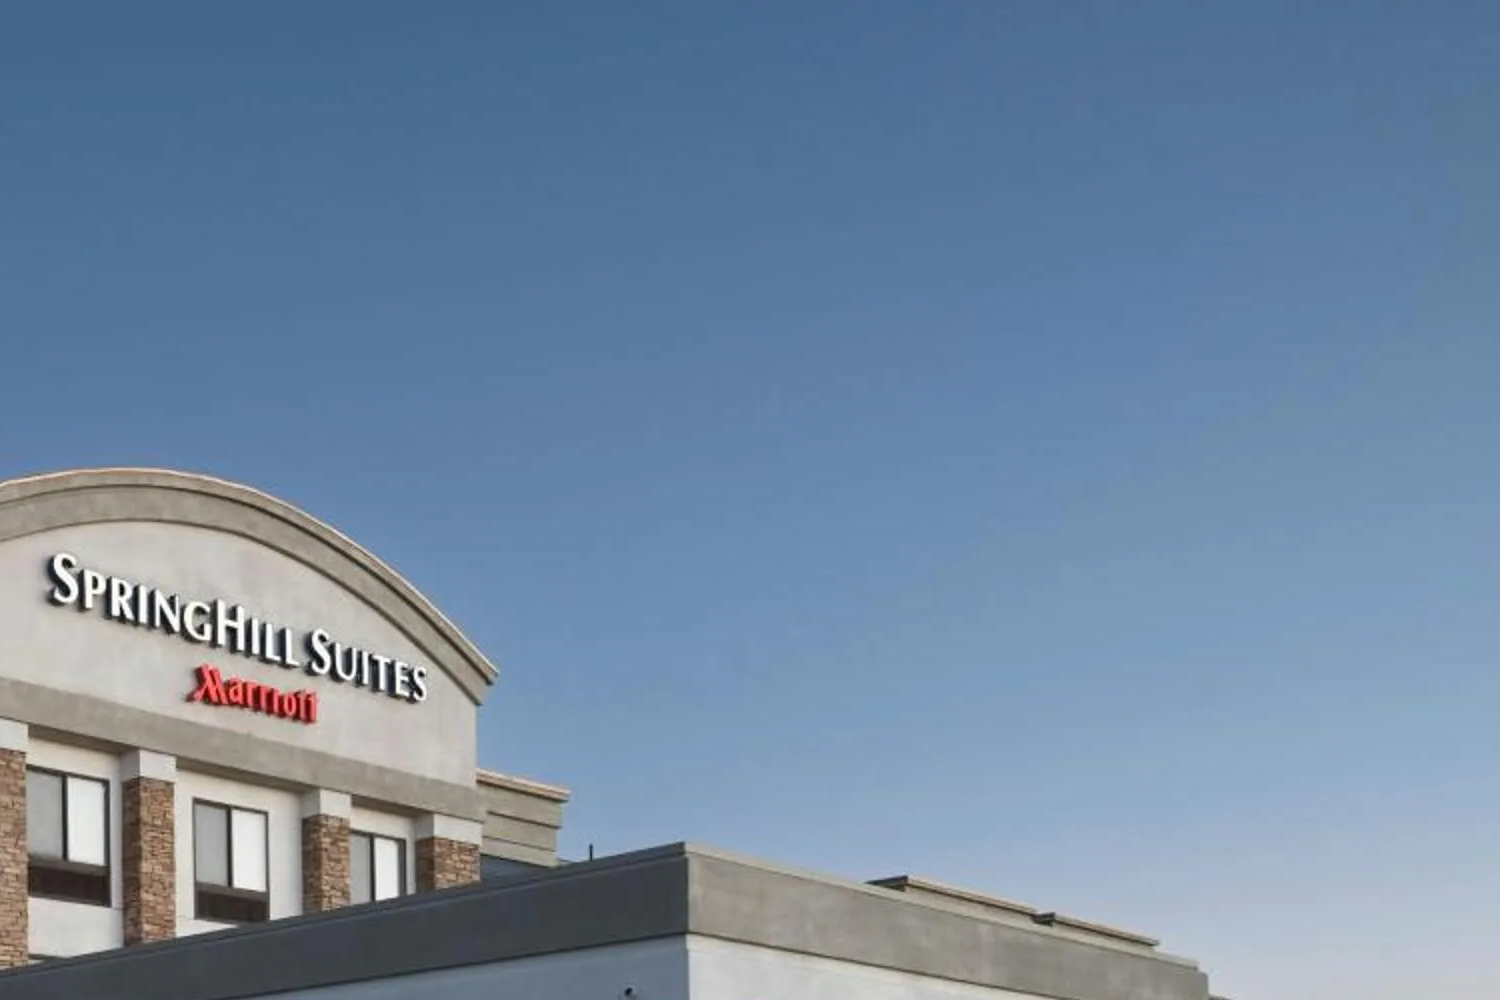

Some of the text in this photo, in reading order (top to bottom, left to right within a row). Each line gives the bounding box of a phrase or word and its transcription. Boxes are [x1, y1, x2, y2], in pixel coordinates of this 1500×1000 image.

[49, 552, 428, 702] SPRINGHILL SUITES
[189, 663, 317, 723] Marriott
